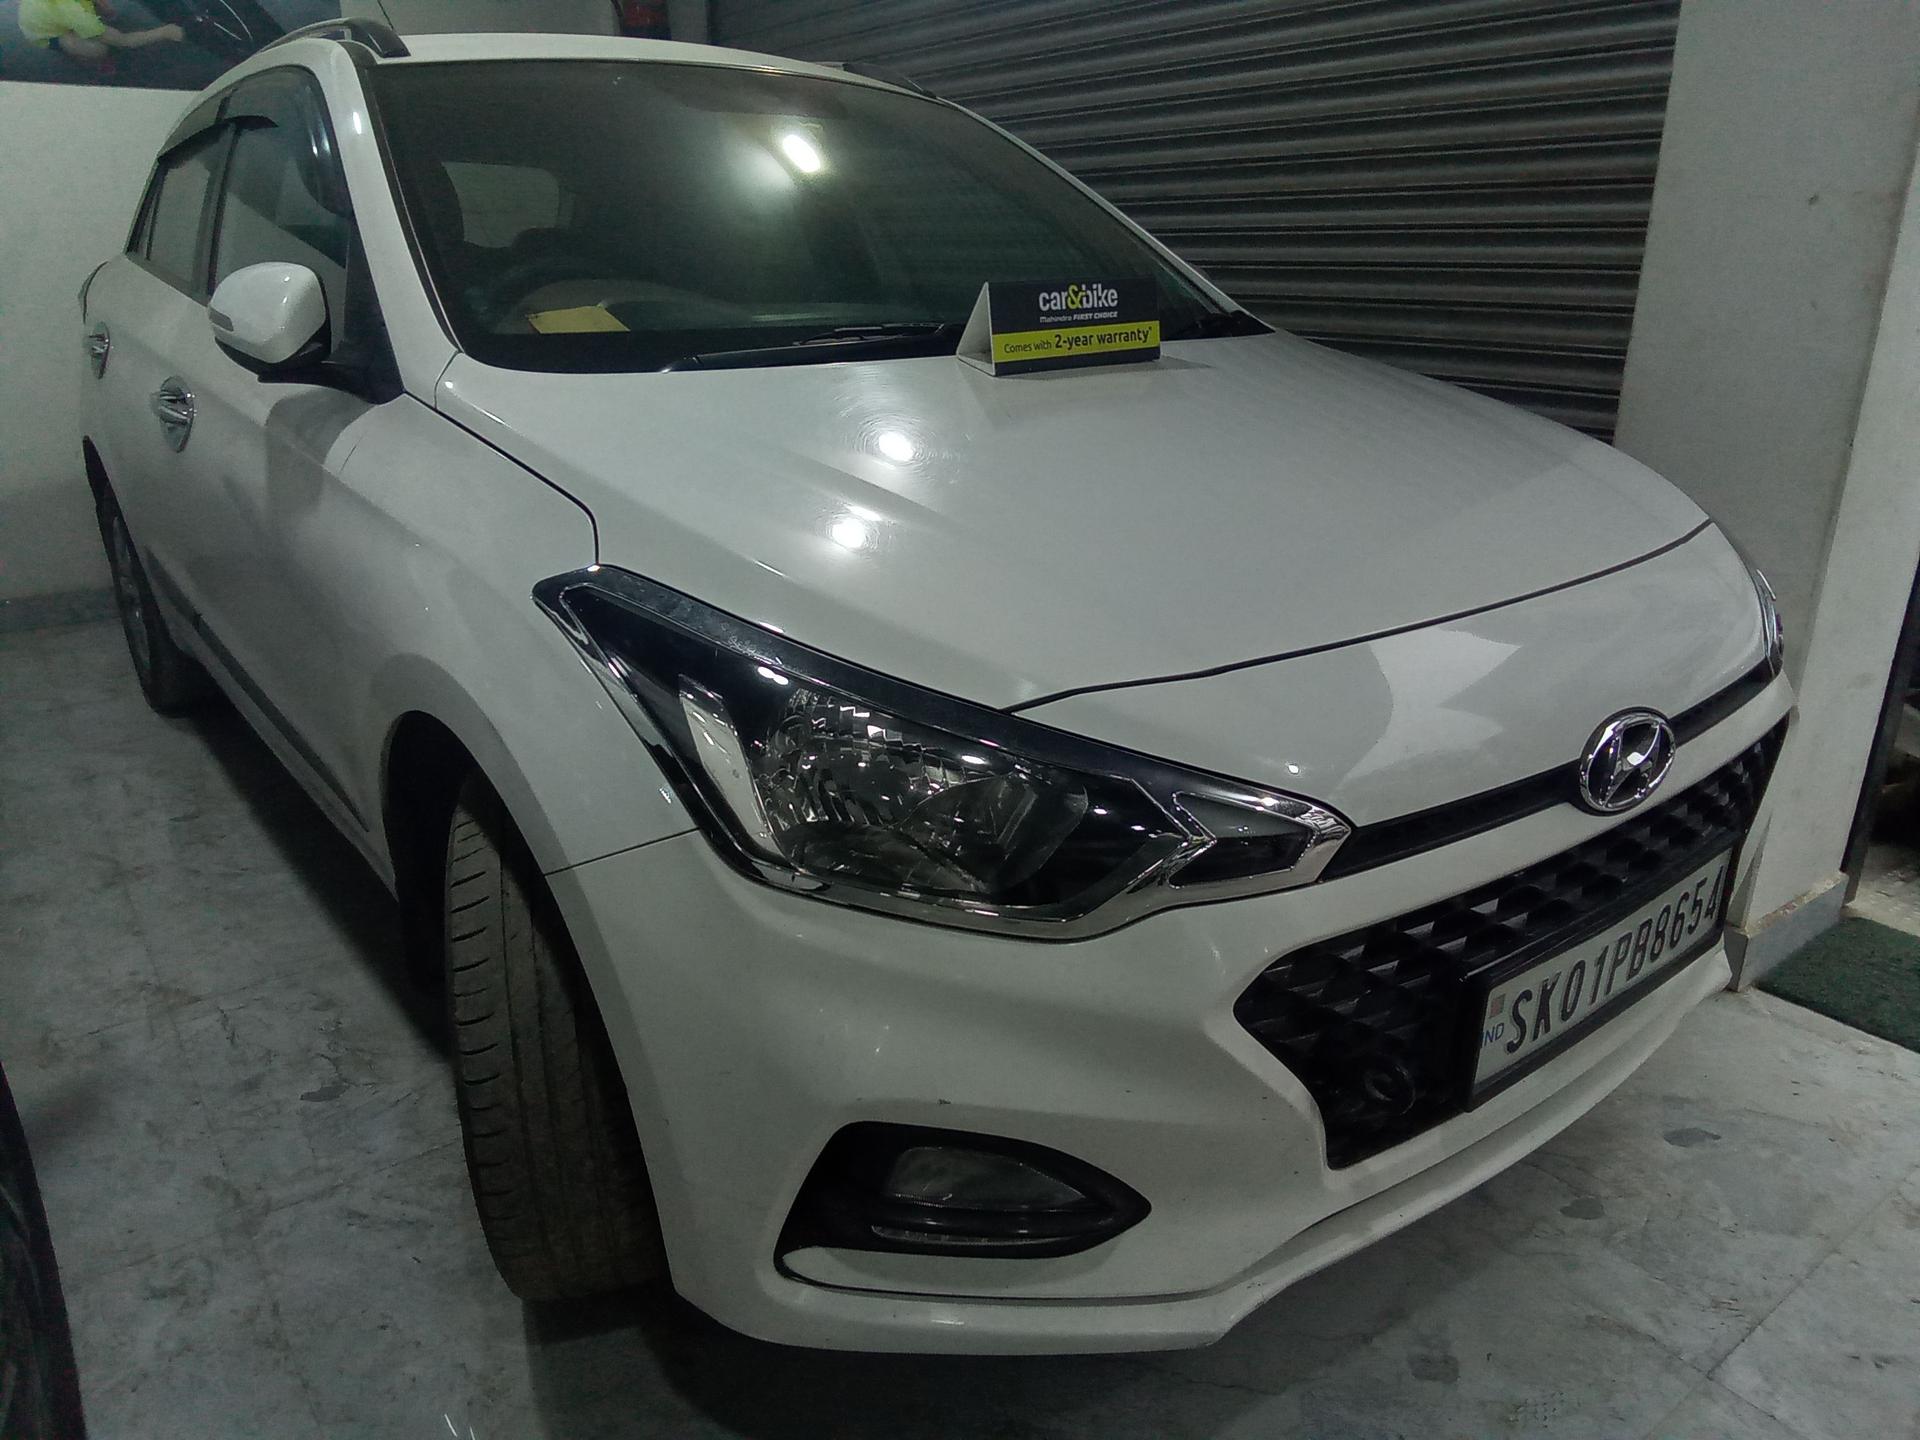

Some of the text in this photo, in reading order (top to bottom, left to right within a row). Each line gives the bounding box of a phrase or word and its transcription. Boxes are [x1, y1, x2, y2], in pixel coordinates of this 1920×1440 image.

[1039, 283, 1118, 312] car&bike
[1073, 313, 1093, 321] FIRST
[1094, 311, 1118, 320] CHOICE
[1004, 343, 1033, 354] Comes
[1034, 340, 1052, 351] with
[1055, 333, 1094, 351] 2-year
[1506, 864, 1724, 1054] SK01PB8654
